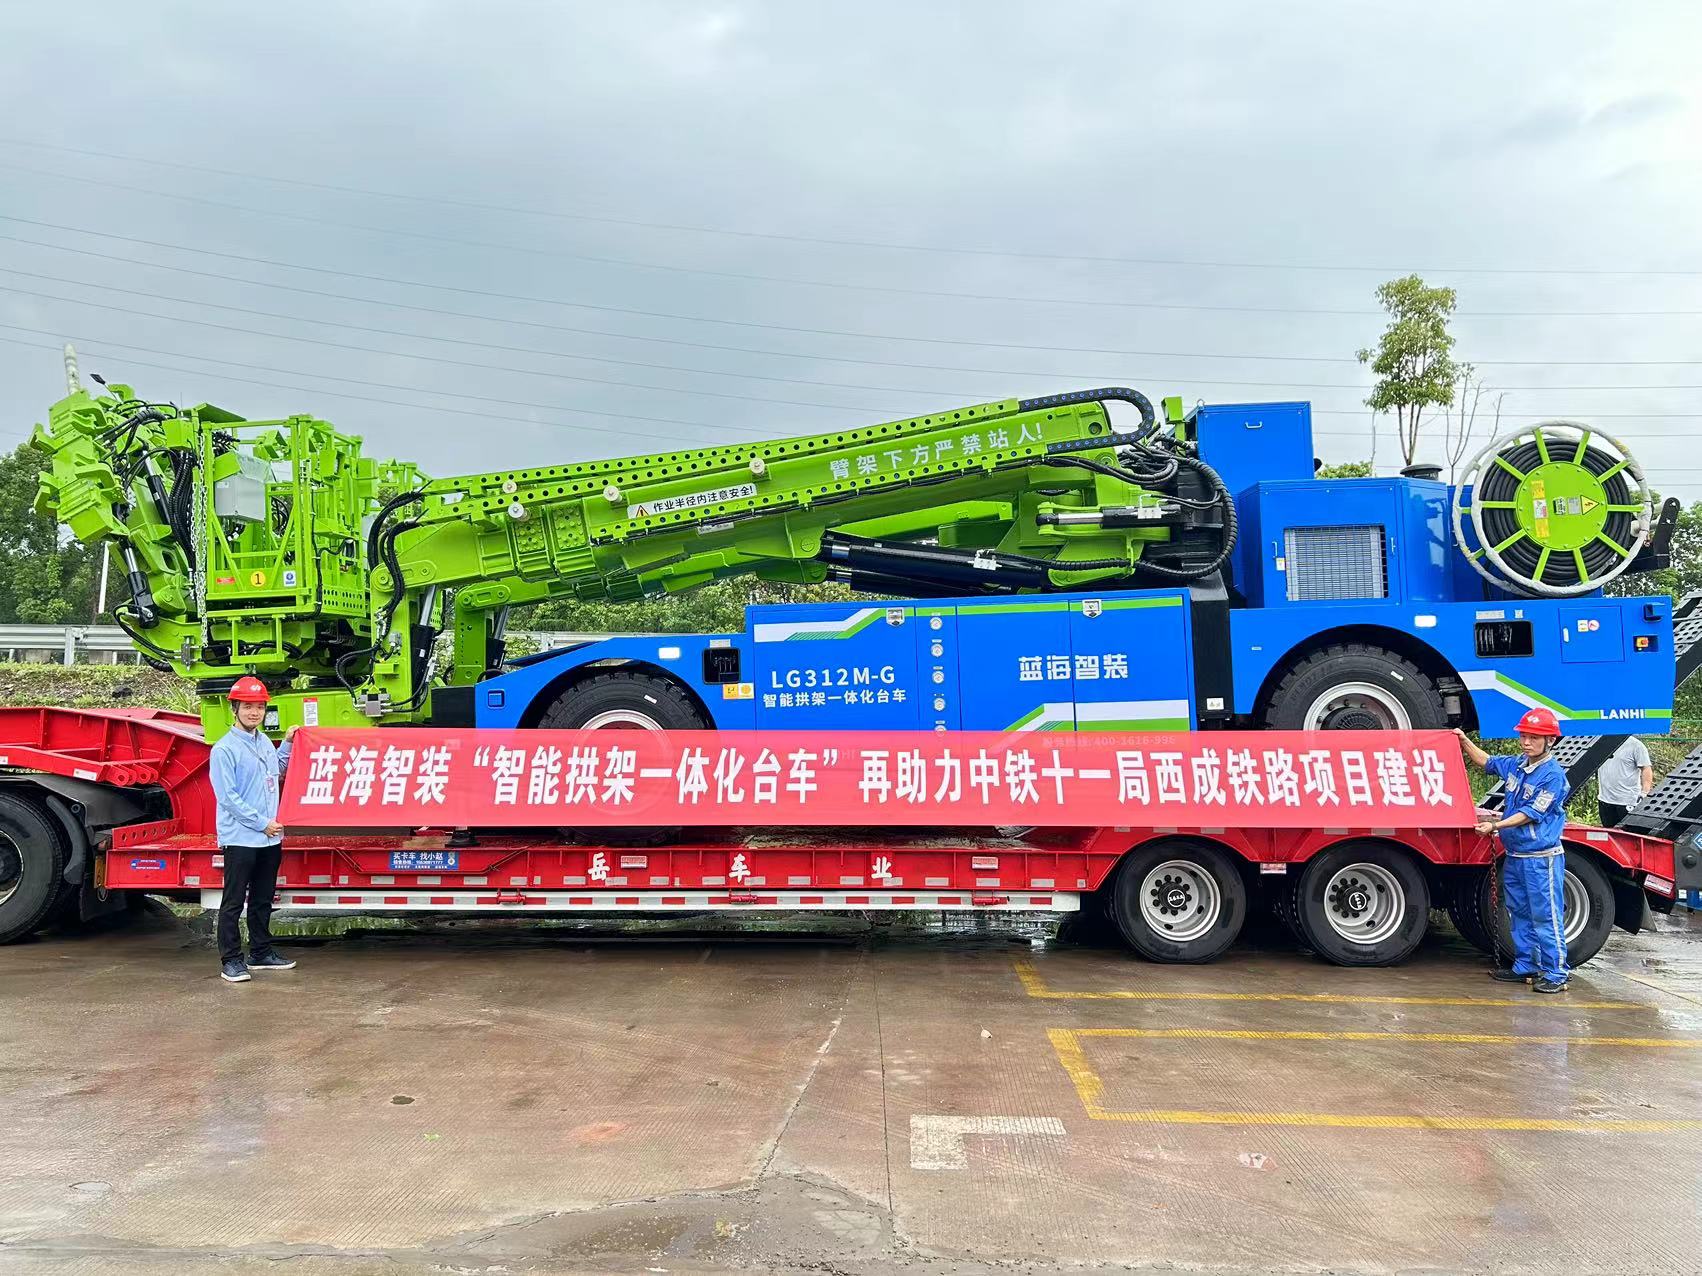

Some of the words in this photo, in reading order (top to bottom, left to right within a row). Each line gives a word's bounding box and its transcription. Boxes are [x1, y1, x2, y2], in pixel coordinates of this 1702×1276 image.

[829, 422, 1044, 481] 臂架下方严禁站人!
[653, 485, 754, 513] 作业半径内注意安全!
[254, 573, 262, 585] 1
[771, 665, 896, 689] LG312M-G
[1018, 653, 1129, 682] 蓝海智装
[762, 688, 907, 708] 智能拱架一体化台车
[1600, 708, 1645, 720] LANHI
[728, 853, 751, 883] 车
[871, 856, 893, 879] 业
